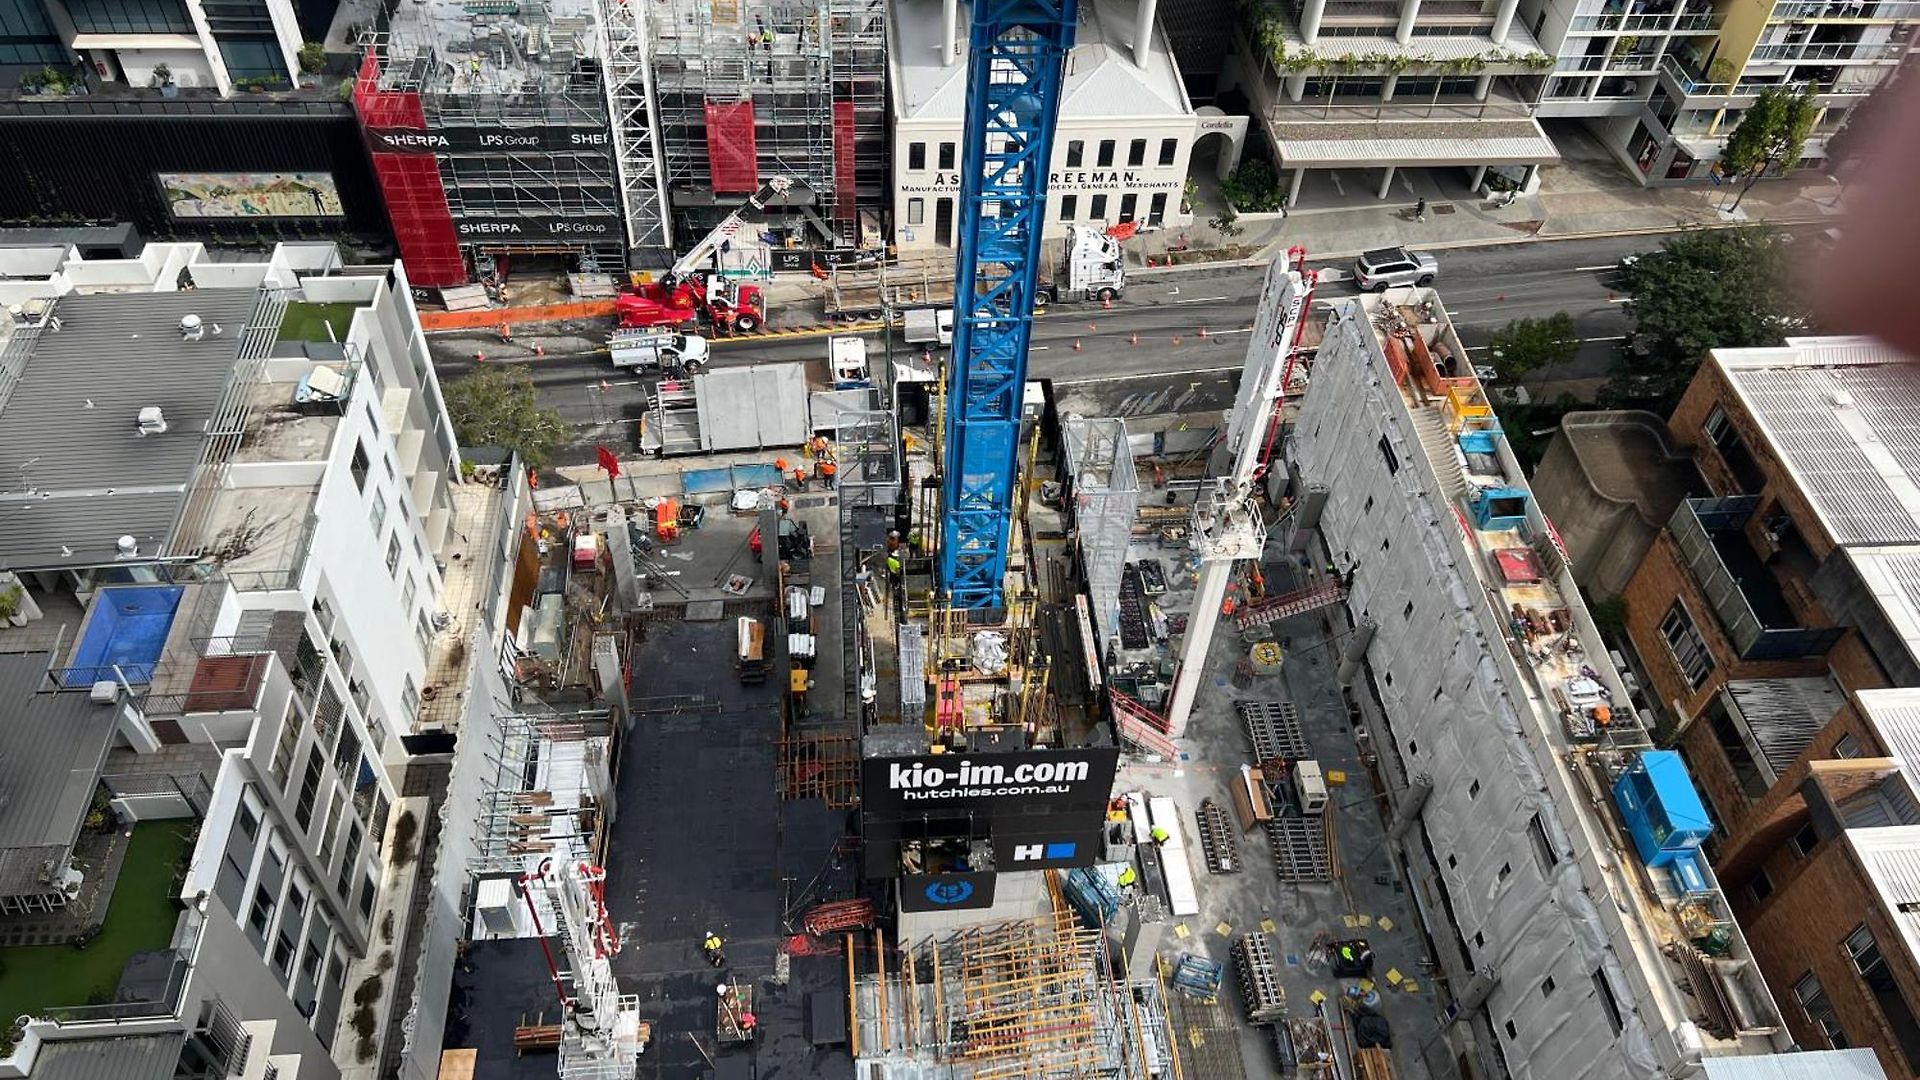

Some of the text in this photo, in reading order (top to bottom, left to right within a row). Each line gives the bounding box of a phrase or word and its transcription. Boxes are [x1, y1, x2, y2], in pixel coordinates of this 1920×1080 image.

[384, 135, 450, 147] SHERPA
[480, 135, 504, 146] LPS
[505, 136, 540, 146] Group
[1050, 171, 1141, 183] REEMAN.
[460, 223, 606, 234] SHERPA LPS Group
[889, 760, 1090, 789] kio-im.com
[903, 784, 1071, 801] hutchies.com.au
